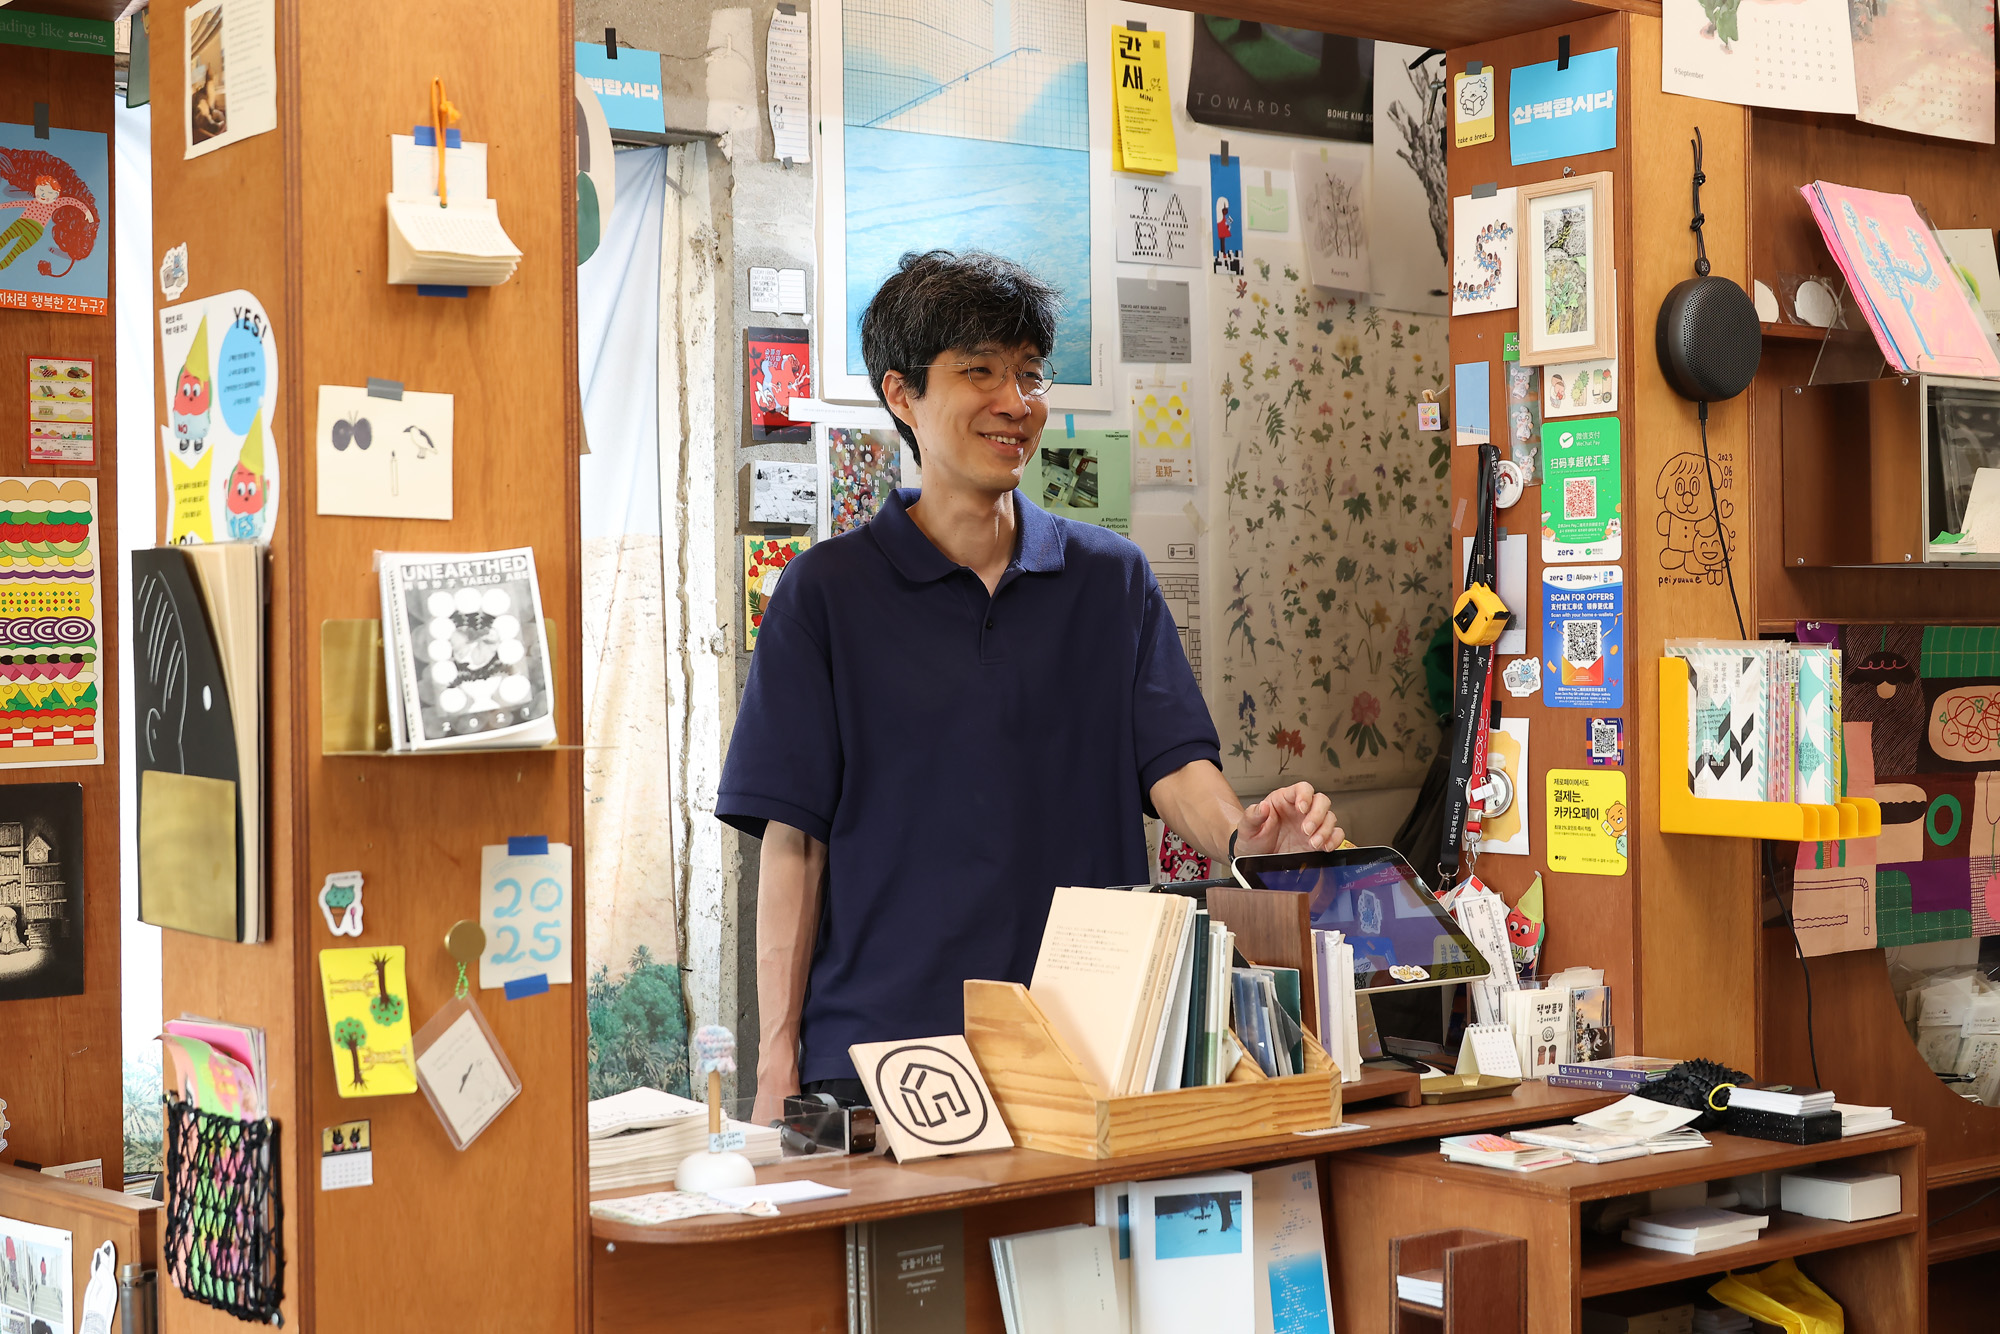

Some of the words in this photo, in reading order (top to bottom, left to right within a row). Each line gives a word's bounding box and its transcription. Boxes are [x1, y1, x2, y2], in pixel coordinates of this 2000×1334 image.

[41, 22, 64, 38] like
[1678, 68, 1704, 80] September
[1196, 92, 1291, 117] TOWARDS
[1511, 90, 1614, 125] 산책합시다
[1327, 109, 1349, 120] BOHIE
[1351, 110, 1364, 121] KIM
[1457, 136, 1468, 144] take
[32, 294, 64, 310] 행복한
[67, 298, 77, 312] 건
[79, 299, 105, 313] 누구?
[233, 306, 267, 344] YES!
[1576, 431, 1600, 440] 微信支付
[1550, 454, 1610, 469] 扫码享超优汇率
[1718, 453, 1733, 462] 2023
[1155, 465, 1180, 477] 星期一
[1723, 465, 1733, 477] 06
[1723, 478, 1733, 490] 07
[401, 556, 528, 581] UNEARTHED
[461, 573, 501, 587] TAEKO
[1550, 593, 1570, 601] SCAN
[1571, 593, 1586, 601] FOR
[1586, 592, 1614, 600] OFFERS
[1461, 649, 1470, 695] 서울국제도서전
[1472, 681, 1481, 694] Fair
[1470, 694, 1479, 710] Book
[1462, 710, 1476, 747] International
[1461, 746, 1470, 765] Seoul
[1474, 735, 1485, 775] 2023
[1554, 778, 1589, 787] 제로페이에서도
[1554, 789, 1584, 803] 결제는.
[1554, 806, 1599, 820] 카카오페이
[1449, 801, 1461, 846] 서울국제도서전
[1150, 954, 1158, 974] Handle
[1165, 953, 1173, 973] Handle
